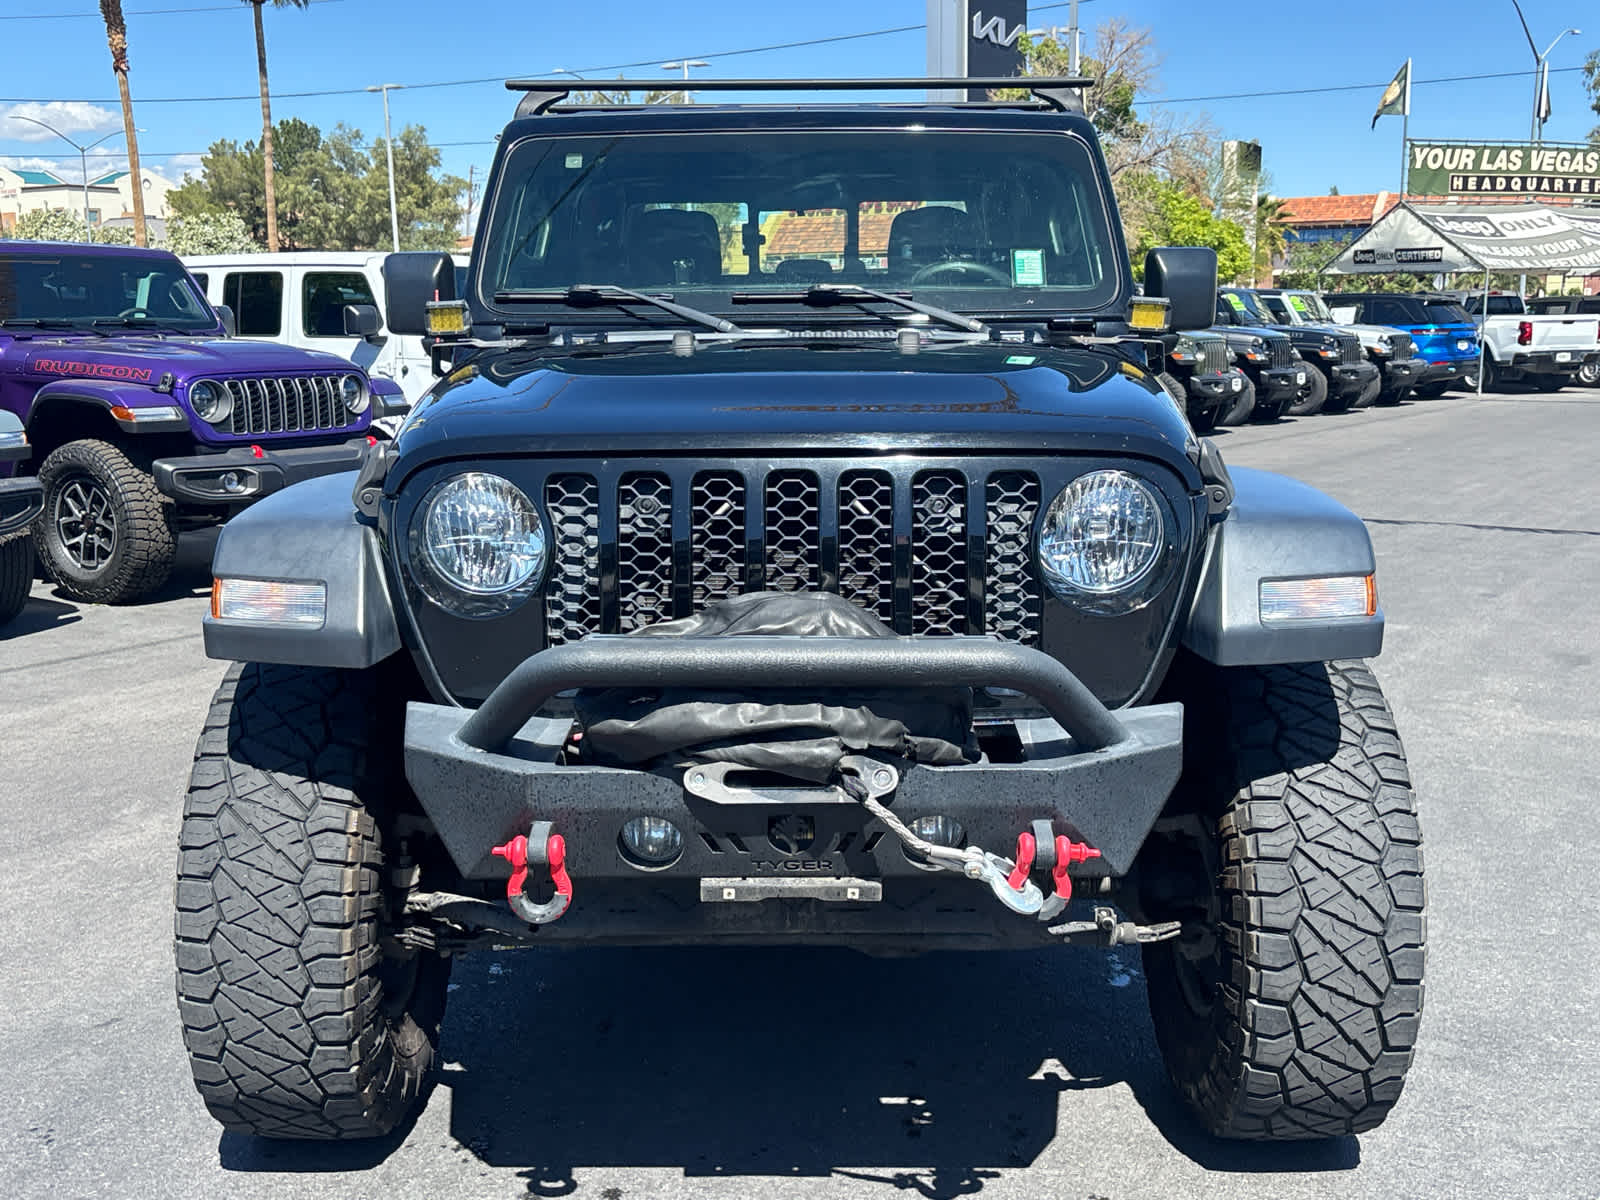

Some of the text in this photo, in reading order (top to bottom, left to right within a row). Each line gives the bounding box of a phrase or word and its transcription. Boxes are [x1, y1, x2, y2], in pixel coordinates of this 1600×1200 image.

[1414, 148, 1600, 173] YOUR LAS VEGAS
[1434, 216, 1496, 236] Jeep
[1499, 215, 1556, 232] ONLY
[1375, 252, 1394, 260] ONLY
[1396, 249, 1442, 260] CERTIFIED
[1532, 239, 1584, 256] YOUR
[34, 359, 152, 381] RUBICON
[751, 859, 833, 872] TYGER
